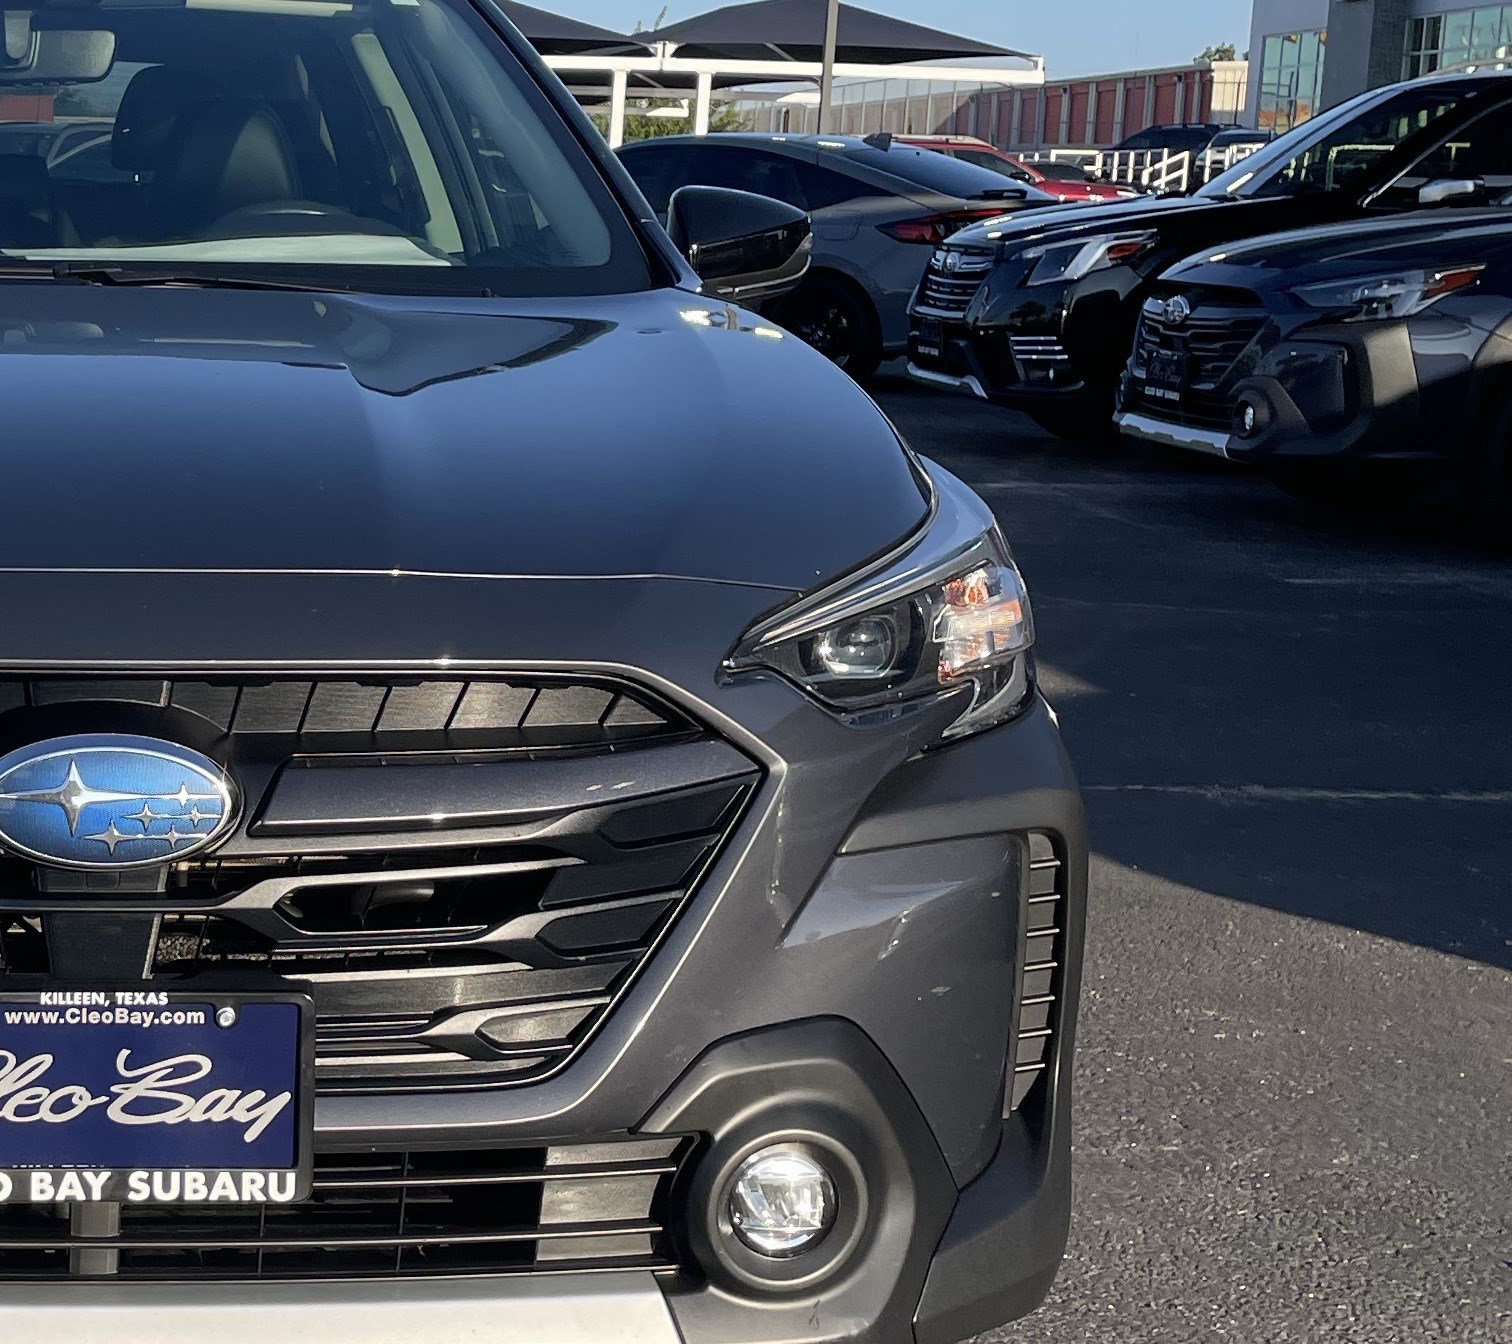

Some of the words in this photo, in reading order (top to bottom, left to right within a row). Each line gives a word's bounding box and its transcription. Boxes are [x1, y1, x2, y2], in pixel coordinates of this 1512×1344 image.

[39, 991, 111, 1006] KILLEEN,
[115, 991, 169, 1006] TEXAS
[4, 1007, 206, 1028] www.CleoBay.com
[106, 1048, 292, 1143] Bay
[30, 1172, 111, 1202] BAY
[127, 1171, 297, 1203] SUBARU
